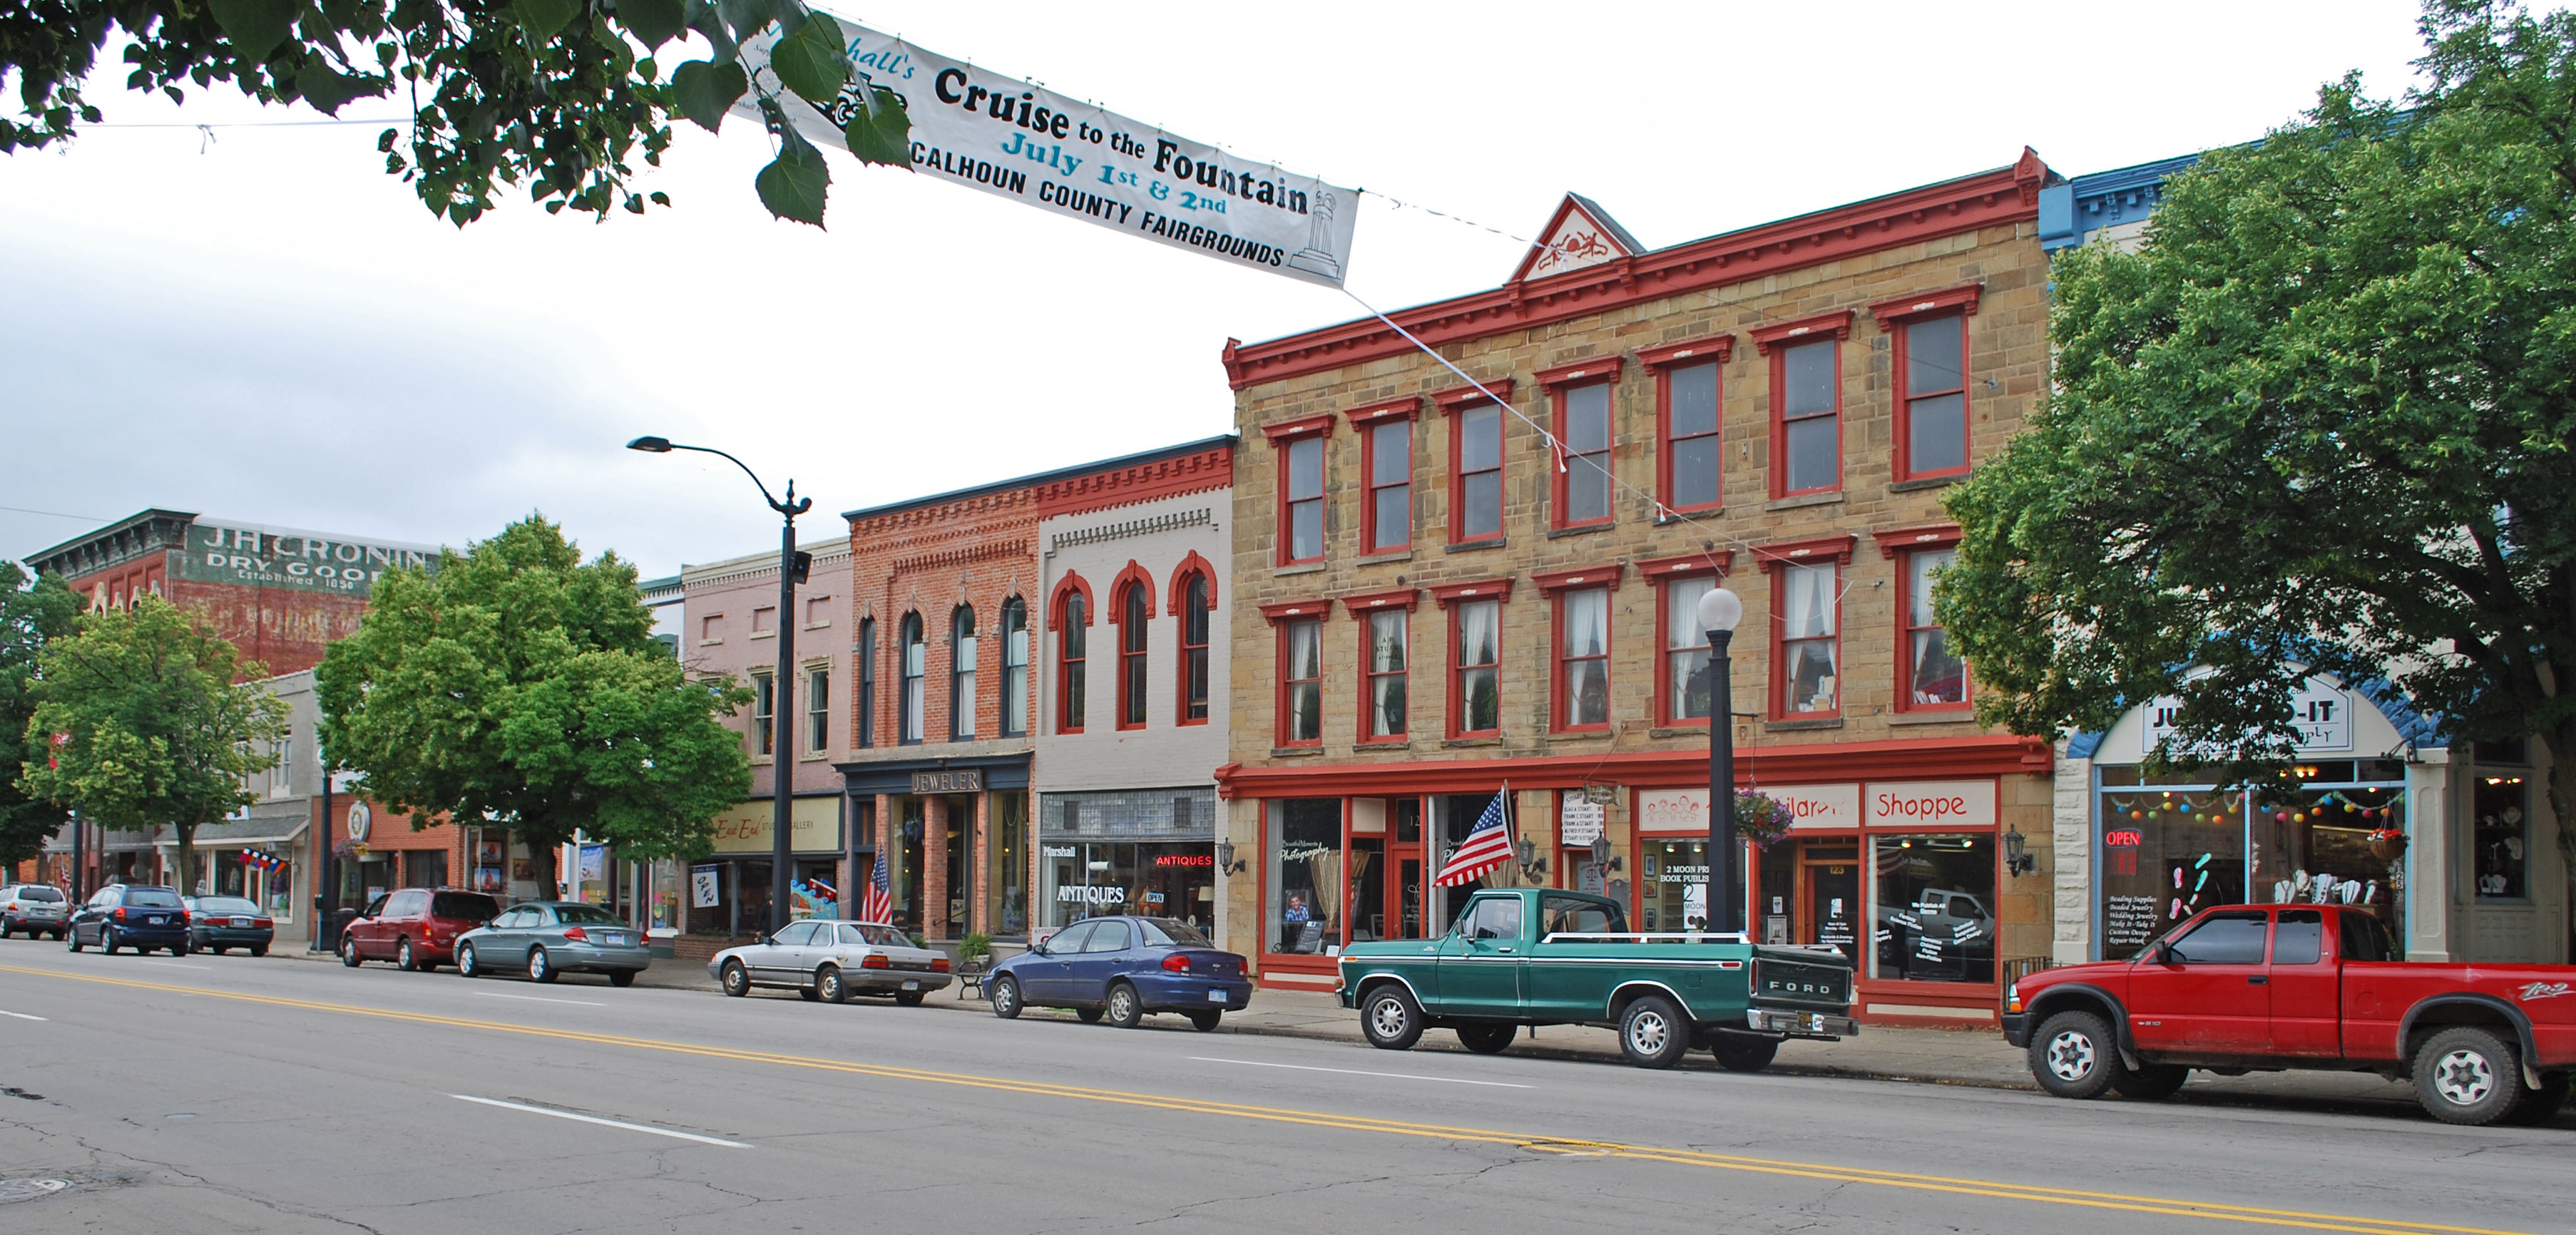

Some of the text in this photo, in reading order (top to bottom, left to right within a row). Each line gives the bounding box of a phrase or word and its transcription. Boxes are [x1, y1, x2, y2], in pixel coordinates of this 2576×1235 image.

[847, 38, 914, 79] hall's
[935, 68, 1308, 215] Cruise to the Fountain
[1001, 132, 1227, 215] July 1st & 2nd
[911, 141, 1284, 267] CALHOUN COUNTY FAIRGROUNDS
[272, 535, 426, 570] CRONIN
[207, 553, 271, 571] DRY
[237, 569, 314, 585] Established
[914, 772, 978, 791] JEWELER
[1877, 793, 1967, 820] Shoppe
[791, 821, 814, 830] ALLERY
[2106, 831, 2140, 846] OPEN
[1043, 846, 1076, 857] Marshall
[1278, 842, 1329, 864] Photography
[1156, 855, 1212, 866] ANTIQUES
[1660, 874, 1682, 883] BOOK
[1057, 885, 1125, 904] ANTIQUES
[1148, 893, 1162, 902] OPEN
[1684, 884, 1695, 902] 2
[2130, 903, 2153, 912] Jewelry
[2135, 912, 2158, 921] Jewelry
[2128, 937, 2146, 946] Work
[1769, 980, 1830, 994] FORD
